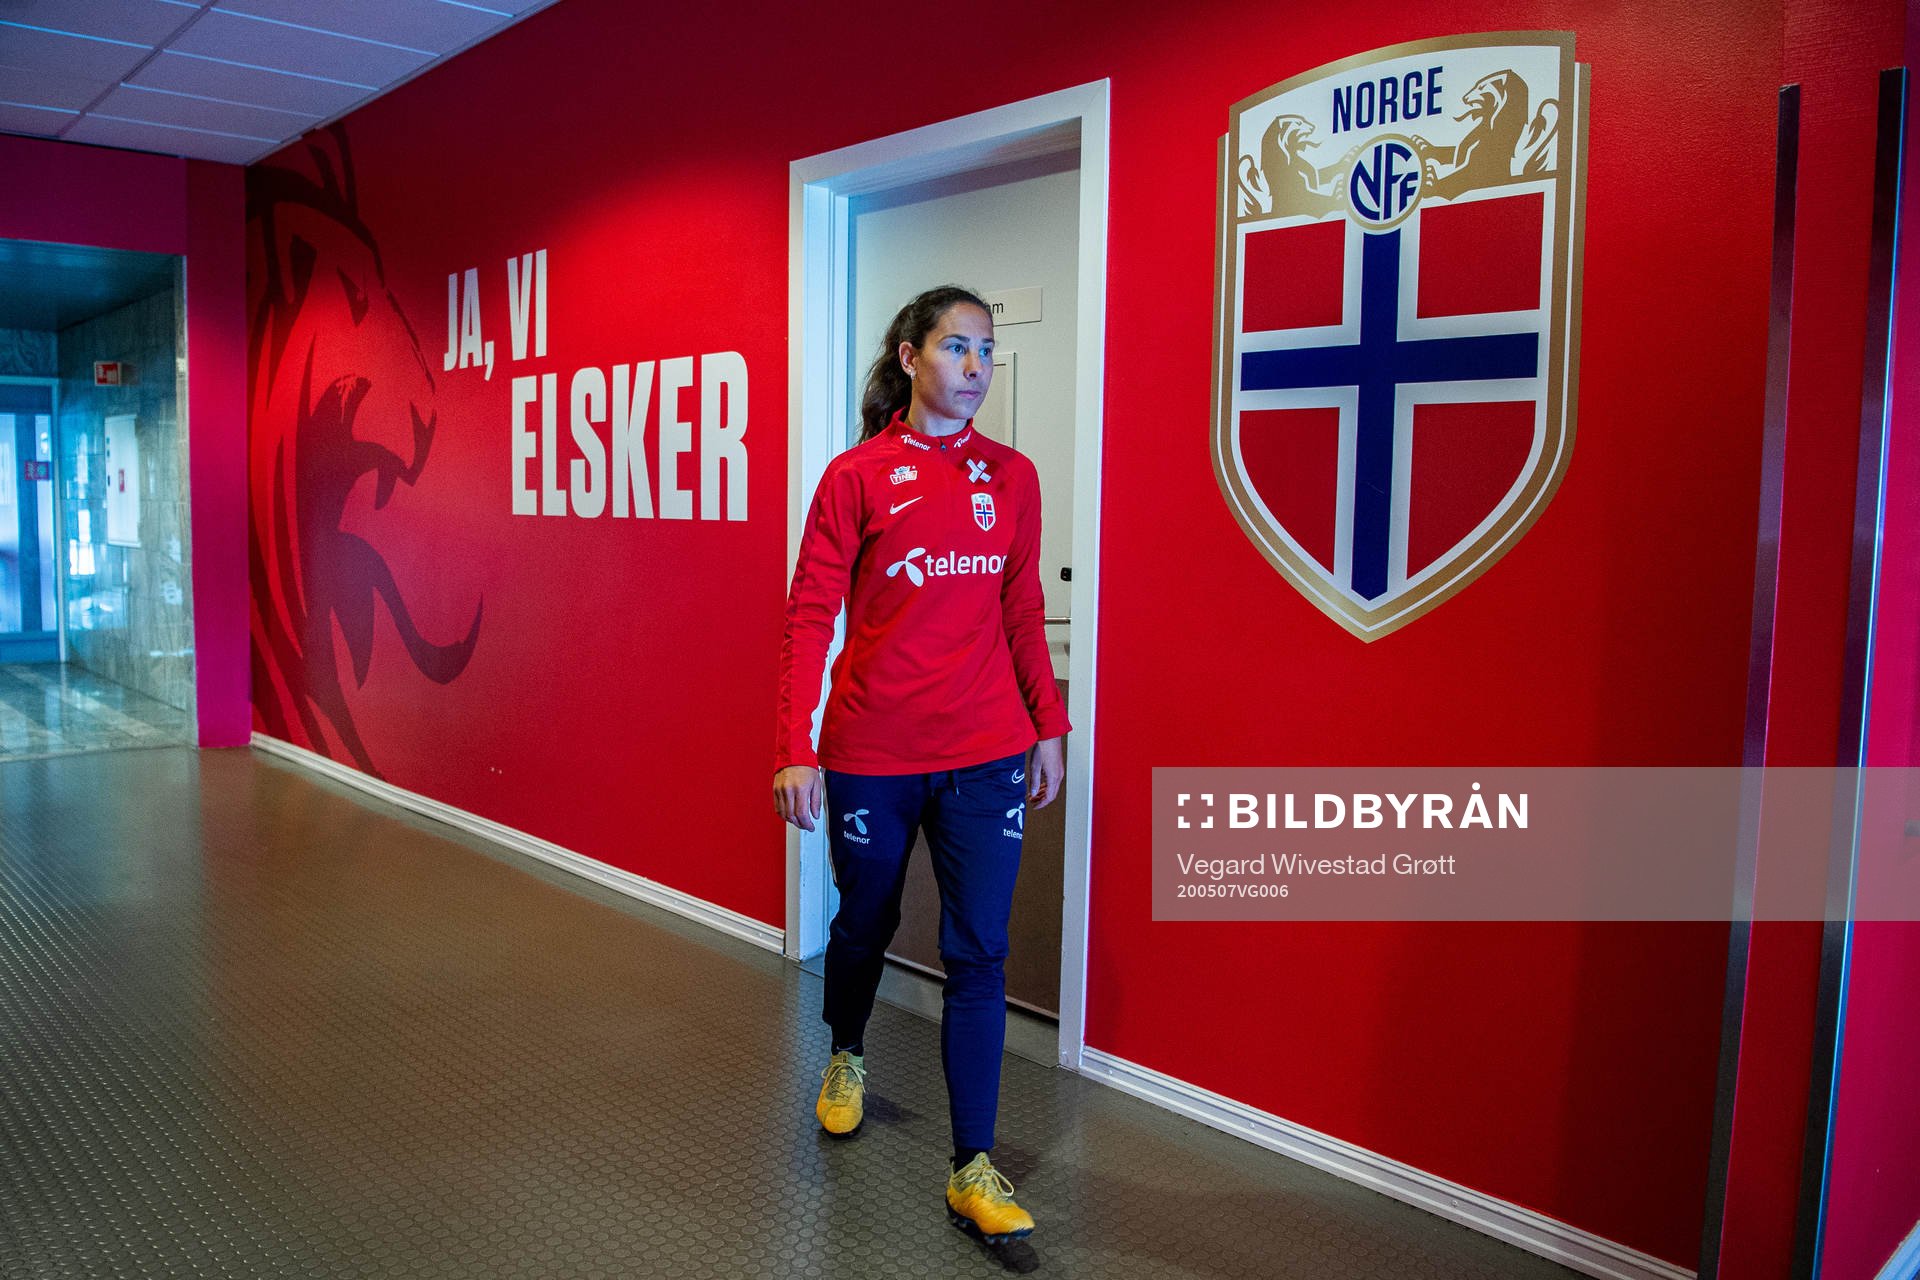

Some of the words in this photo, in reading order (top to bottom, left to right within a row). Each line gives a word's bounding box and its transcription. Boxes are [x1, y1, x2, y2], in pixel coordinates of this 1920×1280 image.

[1332, 66, 1443, 134] NORGE
[1350, 142, 1419, 220] NFF
[444, 267, 494, 381] JA,
[507, 248, 547, 361] VI
[511, 351, 749, 521] ELSKER
[843, 830, 871, 845] telenor
[1003, 828, 1023, 840] teleno
